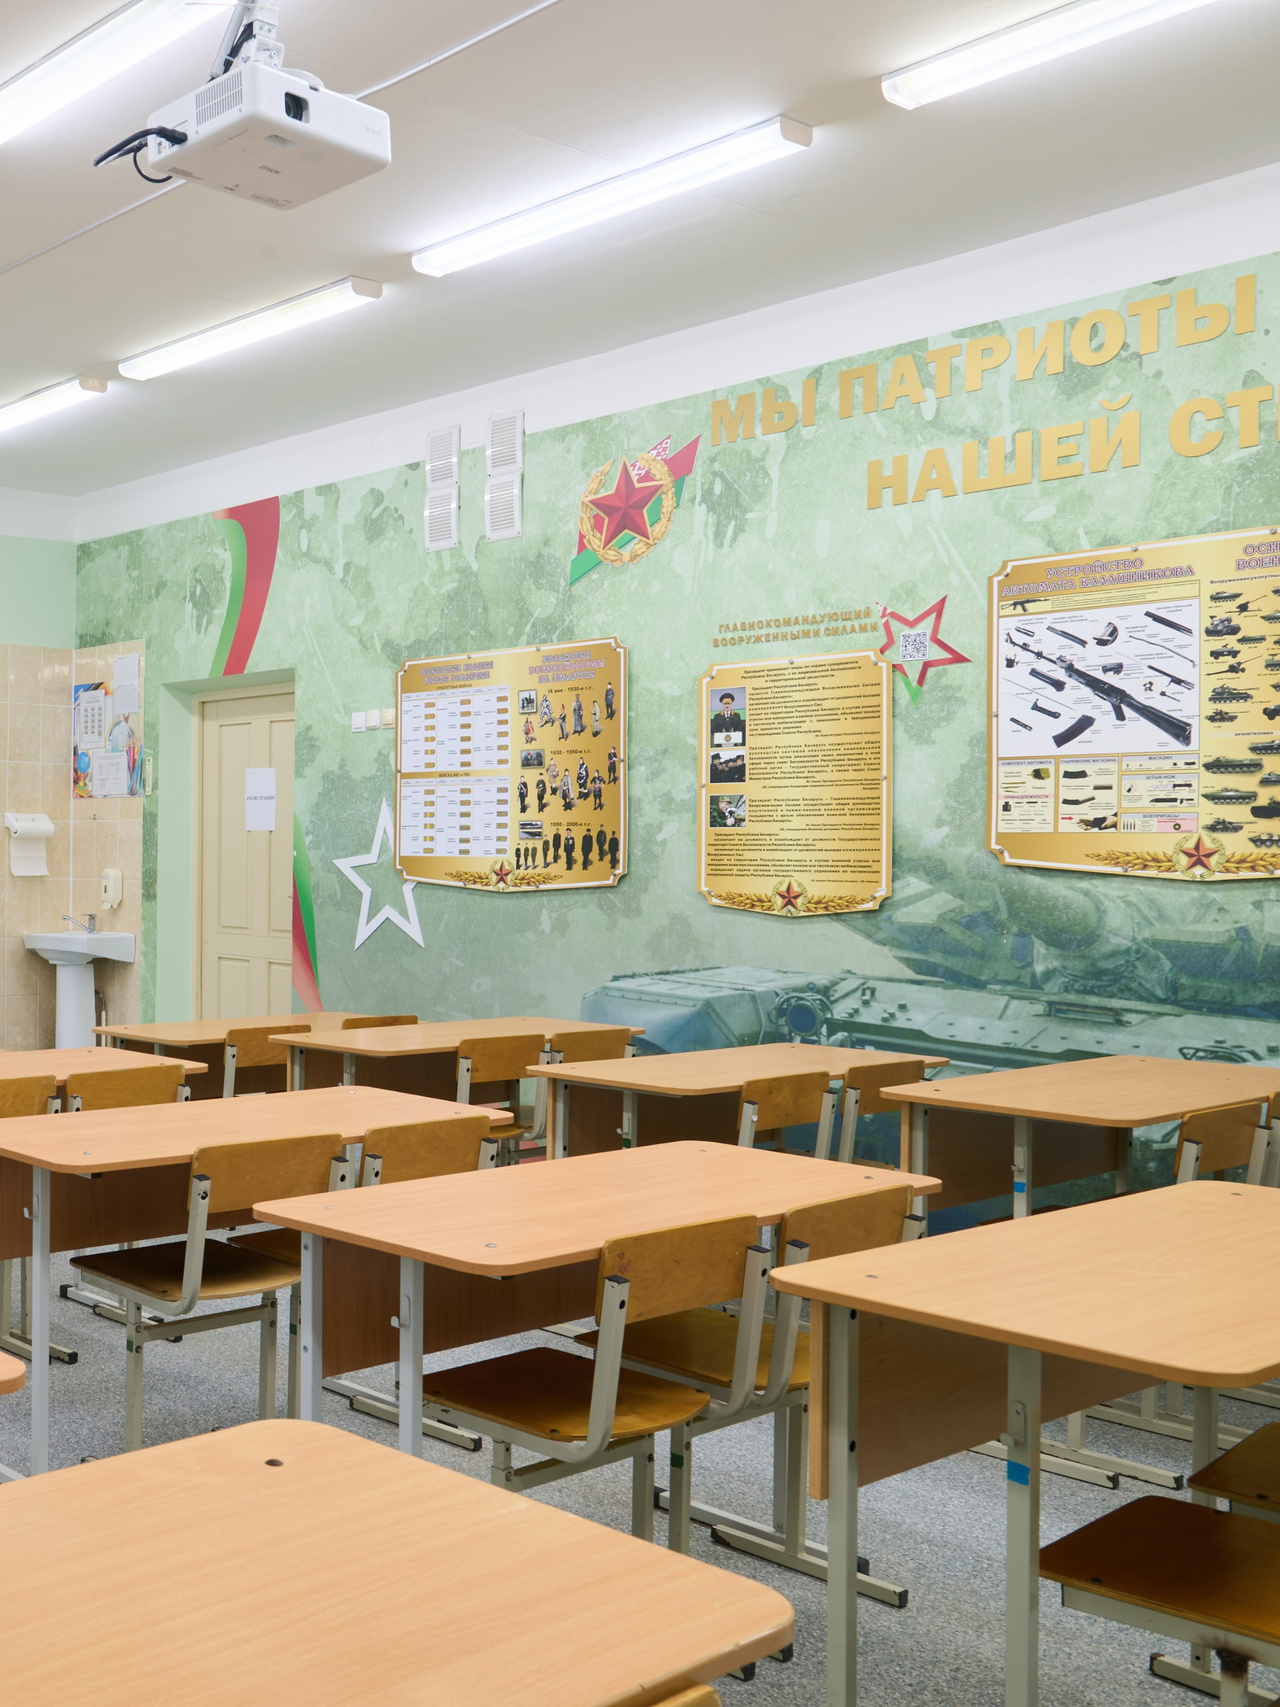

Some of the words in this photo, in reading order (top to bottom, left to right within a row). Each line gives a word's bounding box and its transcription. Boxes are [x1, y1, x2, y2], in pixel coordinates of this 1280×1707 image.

[711, 377, 816, 446] МЫ
[839, 274, 1256, 418] ПАТРИОТЫ
[867, 394, 1141, 509] НАШЕЙ
[1168, 385, 1280, 457] СТ
[1243, 541, 1280, 556] ОСН
[1001, 579, 1077, 596] АВТОМАТА
[1080, 565, 1196, 588] КАЛАШНИКОВА
[1045, 558, 1145, 579] УСТРОЙСТВО
[719, 606, 872, 634] ГЛАВНОКОМАНДУЮЩИЙ
[713, 627, 820, 648] ВООРУЖЕННЫМИ
[824, 622, 879, 637] СИЛАМИ
